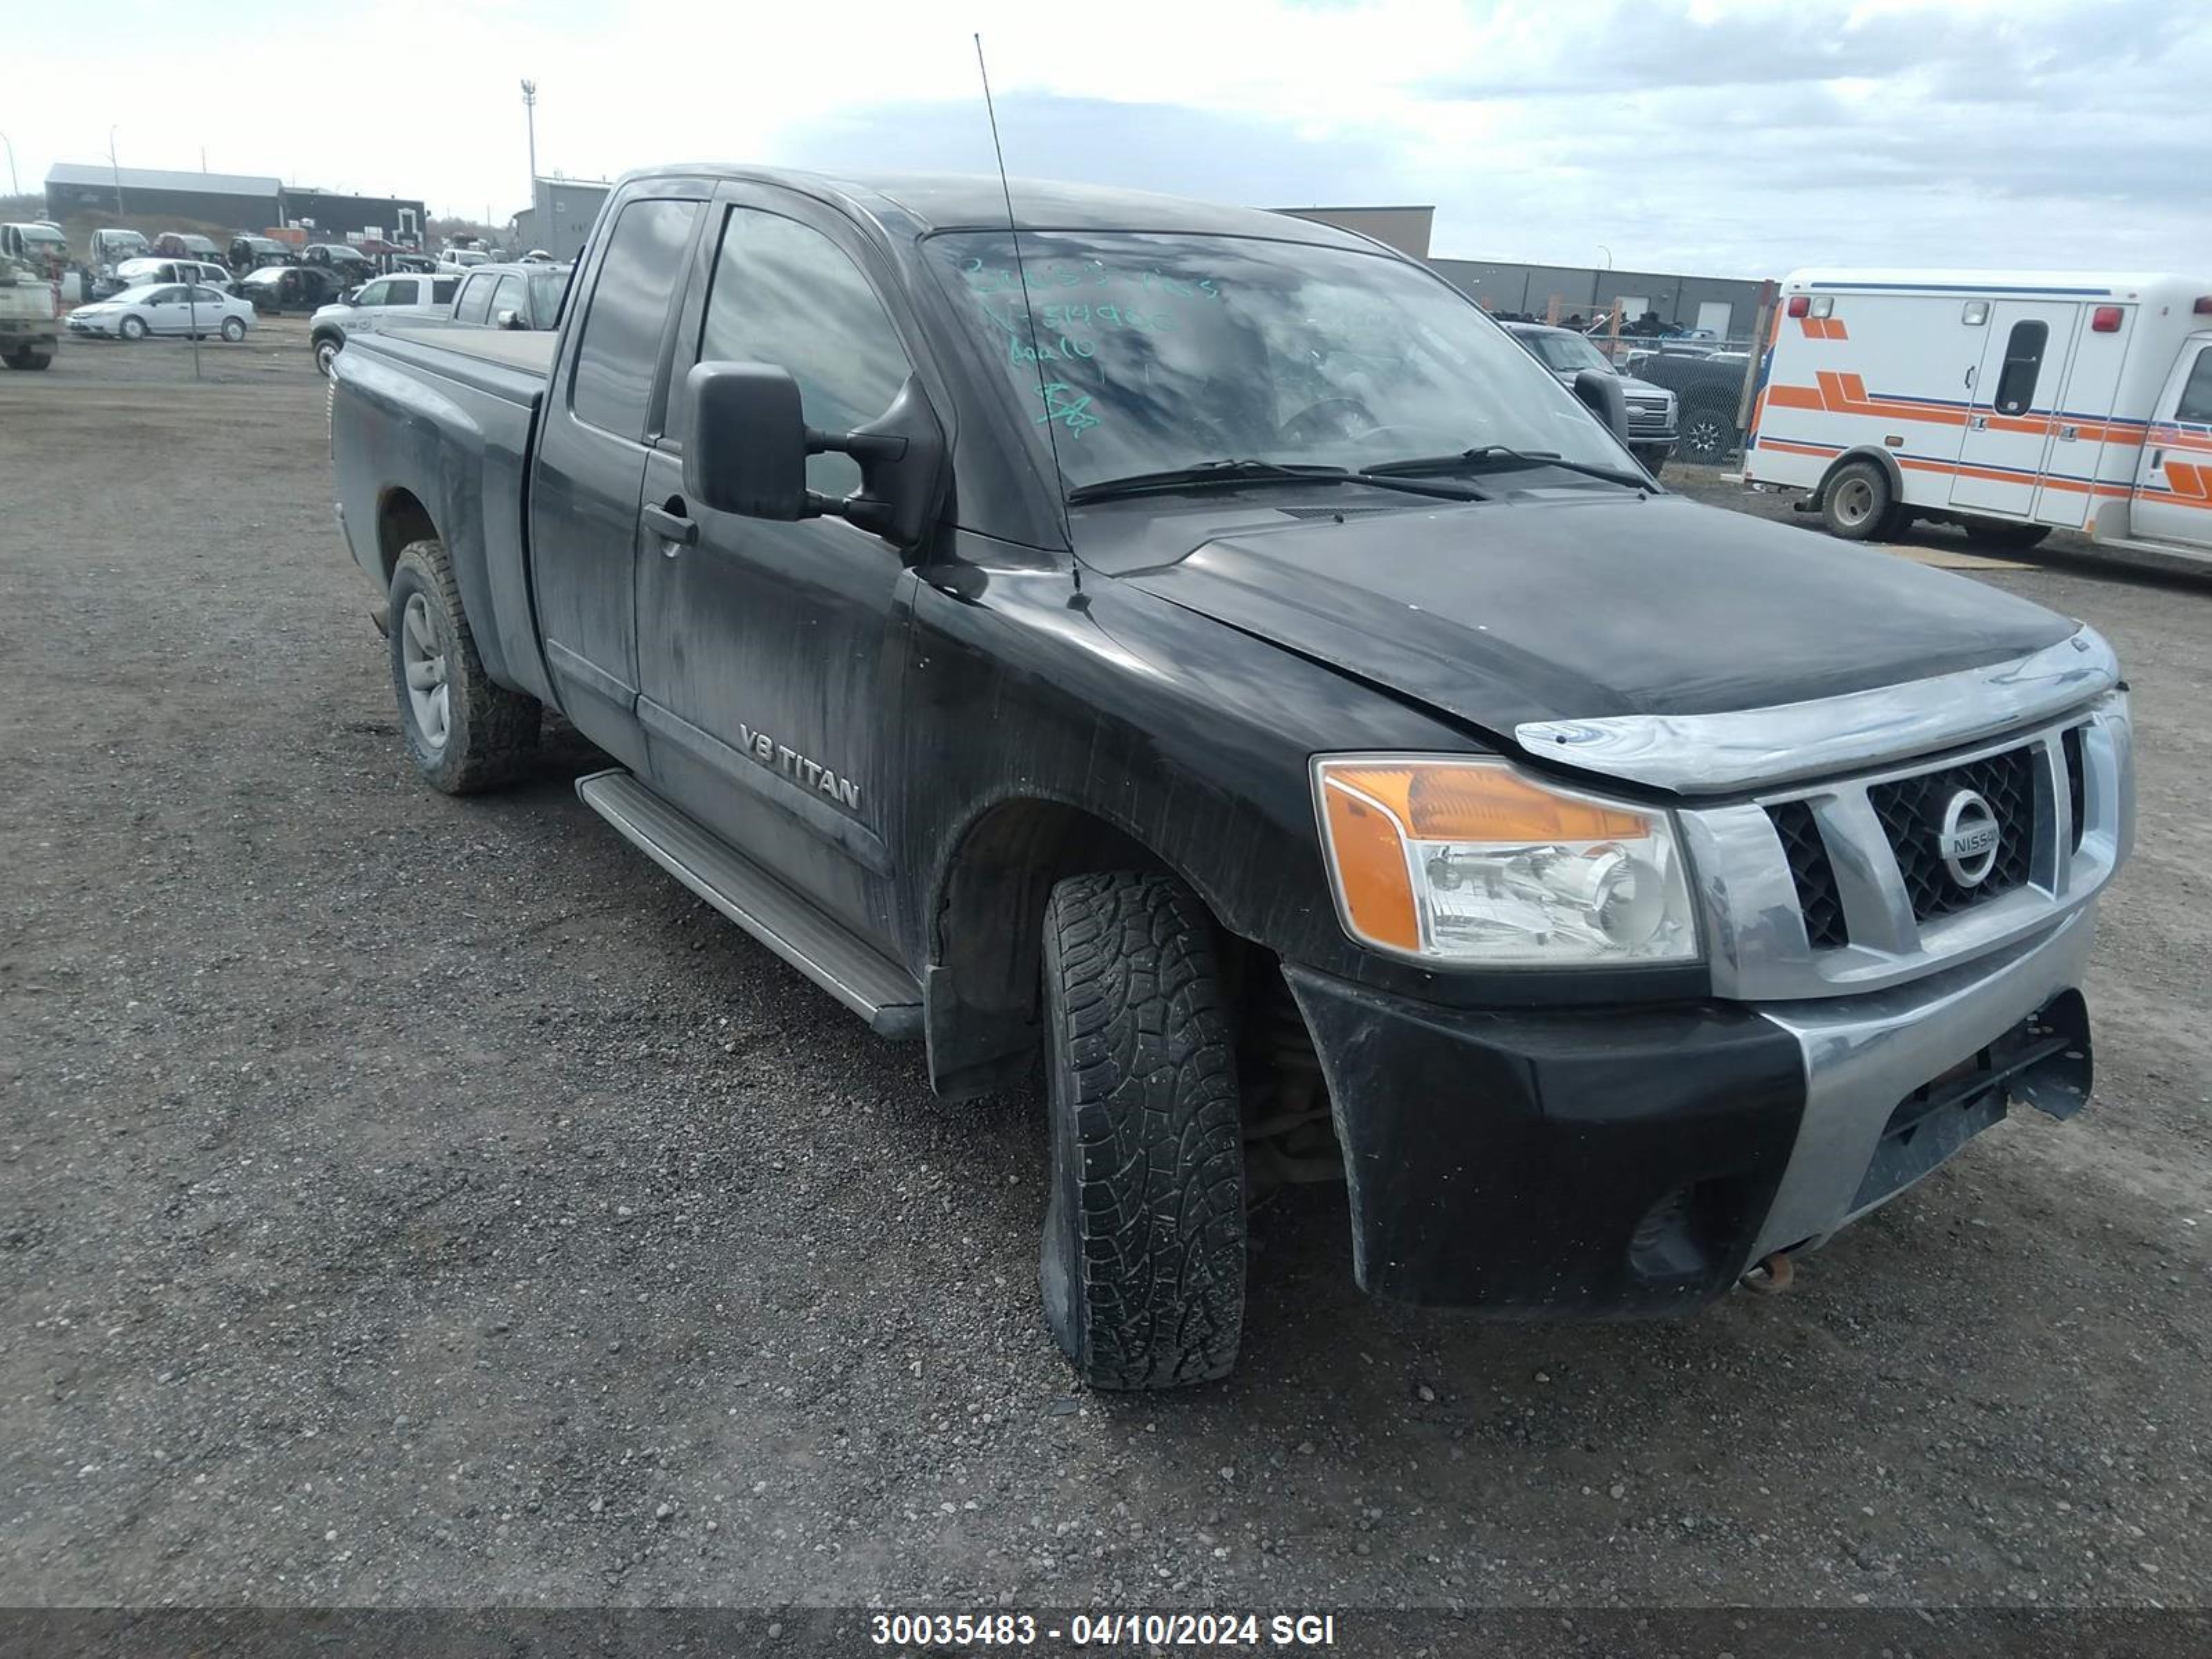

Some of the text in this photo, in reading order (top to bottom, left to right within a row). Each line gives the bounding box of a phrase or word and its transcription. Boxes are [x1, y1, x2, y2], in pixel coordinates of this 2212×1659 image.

[740, 723, 860, 809] V8 TITAN
[1953, 831, 1996, 853] NISSA
